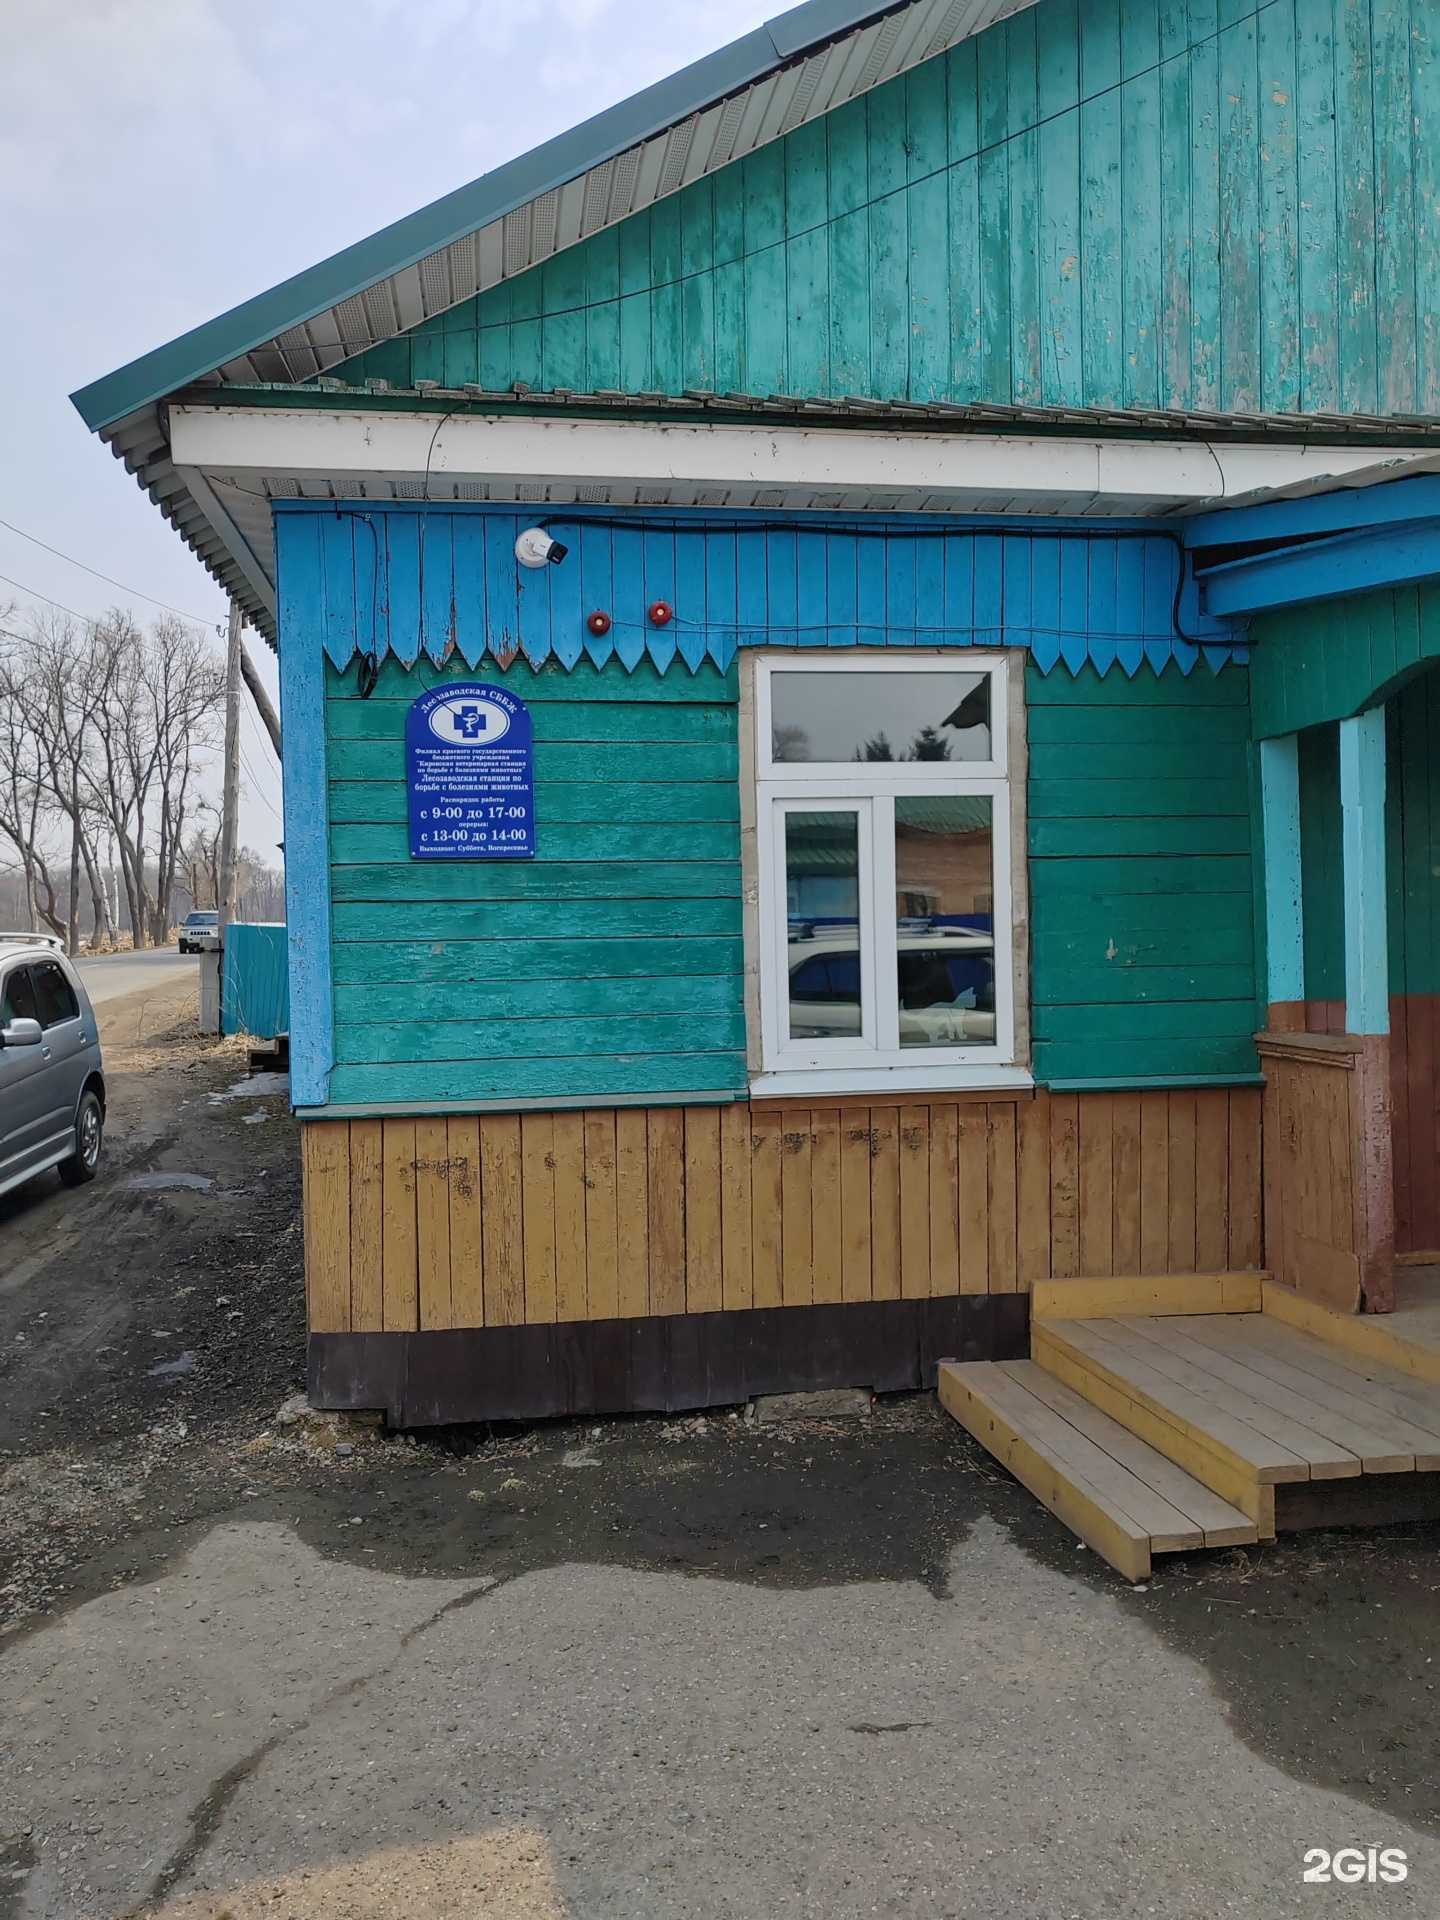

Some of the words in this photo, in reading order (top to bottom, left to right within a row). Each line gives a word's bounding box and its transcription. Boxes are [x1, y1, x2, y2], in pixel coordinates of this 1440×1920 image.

[489, 690, 518, 713] СББЖ
[414, 783, 440, 792] борьбе
[448, 783, 489, 791] болезнями
[420, 810, 428, 819] с
[432, 807, 463, 819] 9-00
[466, 809, 483, 820] до
[488, 806, 526, 818] 17-00
[421, 832, 428, 841] с
[433, 829, 468, 841] 13-00
[471, 832, 487, 842] до
[491, 828, 527, 841] 14-00
